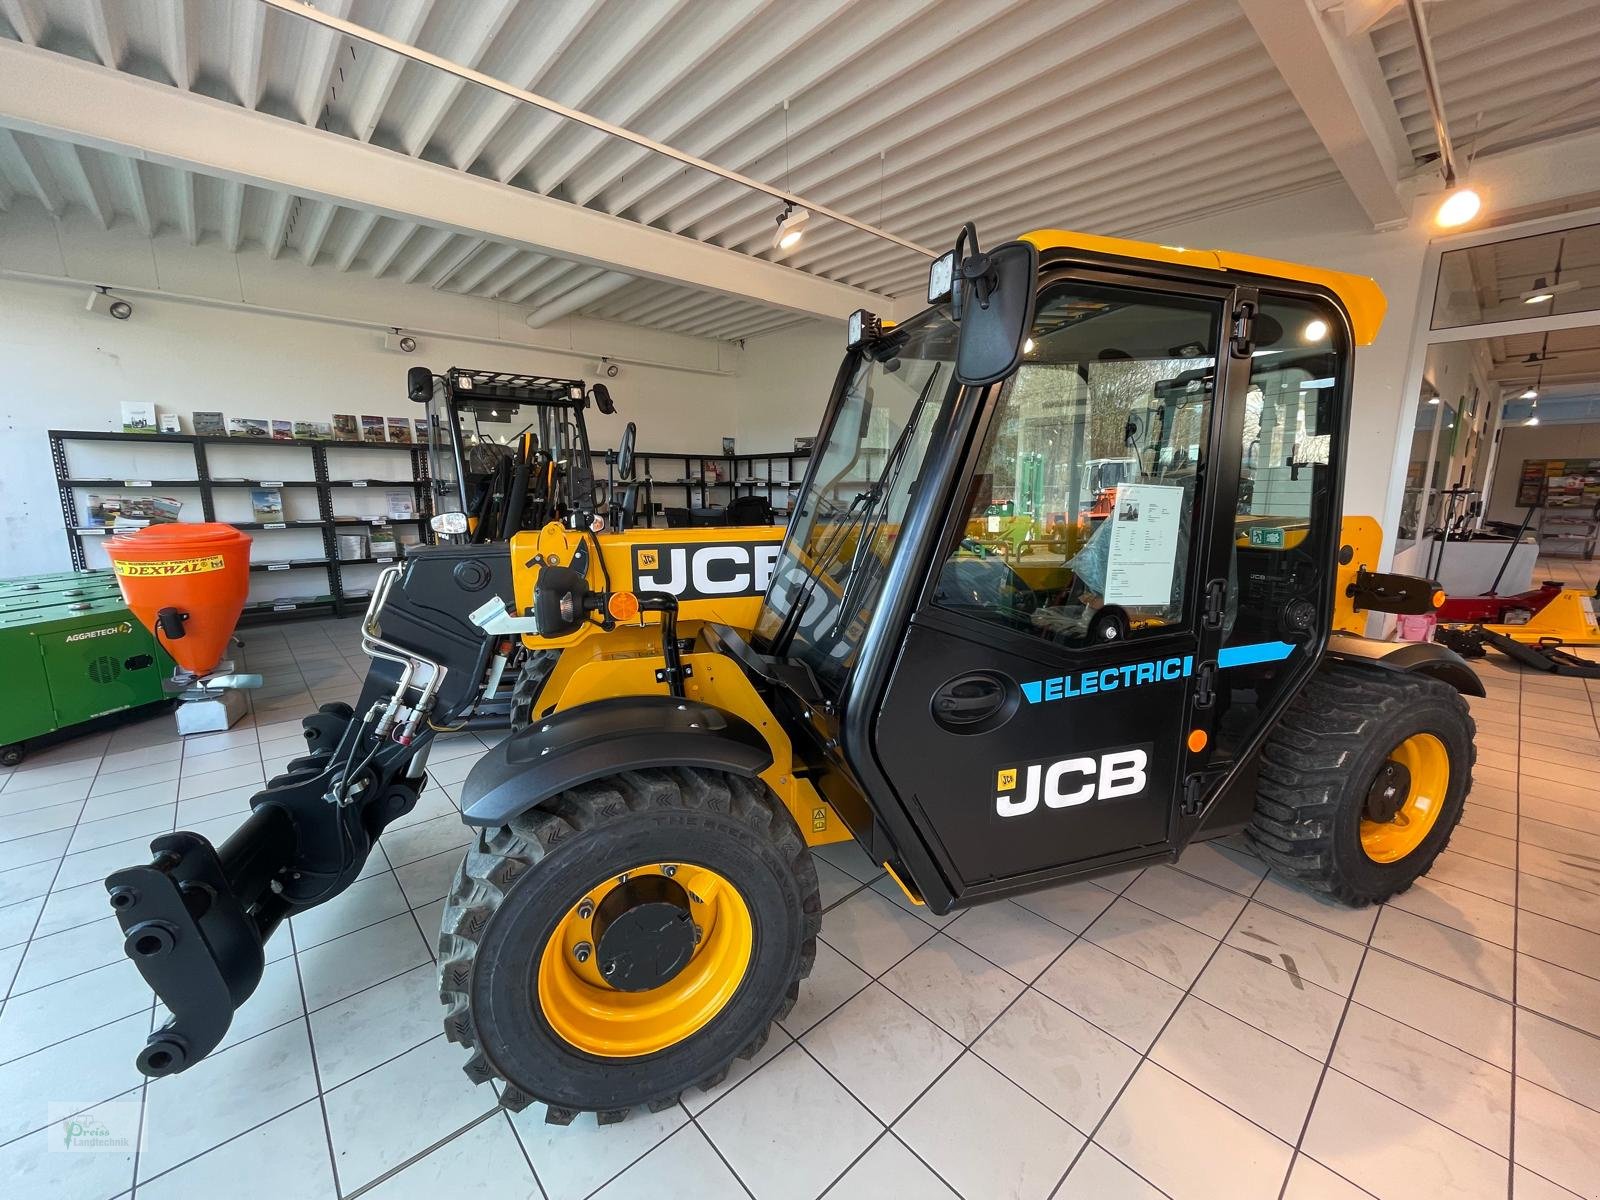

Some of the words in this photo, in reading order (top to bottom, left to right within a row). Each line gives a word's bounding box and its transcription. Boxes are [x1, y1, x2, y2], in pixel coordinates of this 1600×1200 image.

[65, 626, 118, 643] AGGRETECH
[1045, 657, 1181, 702] ELECTRIC
[996, 749, 1148, 818] JCB
